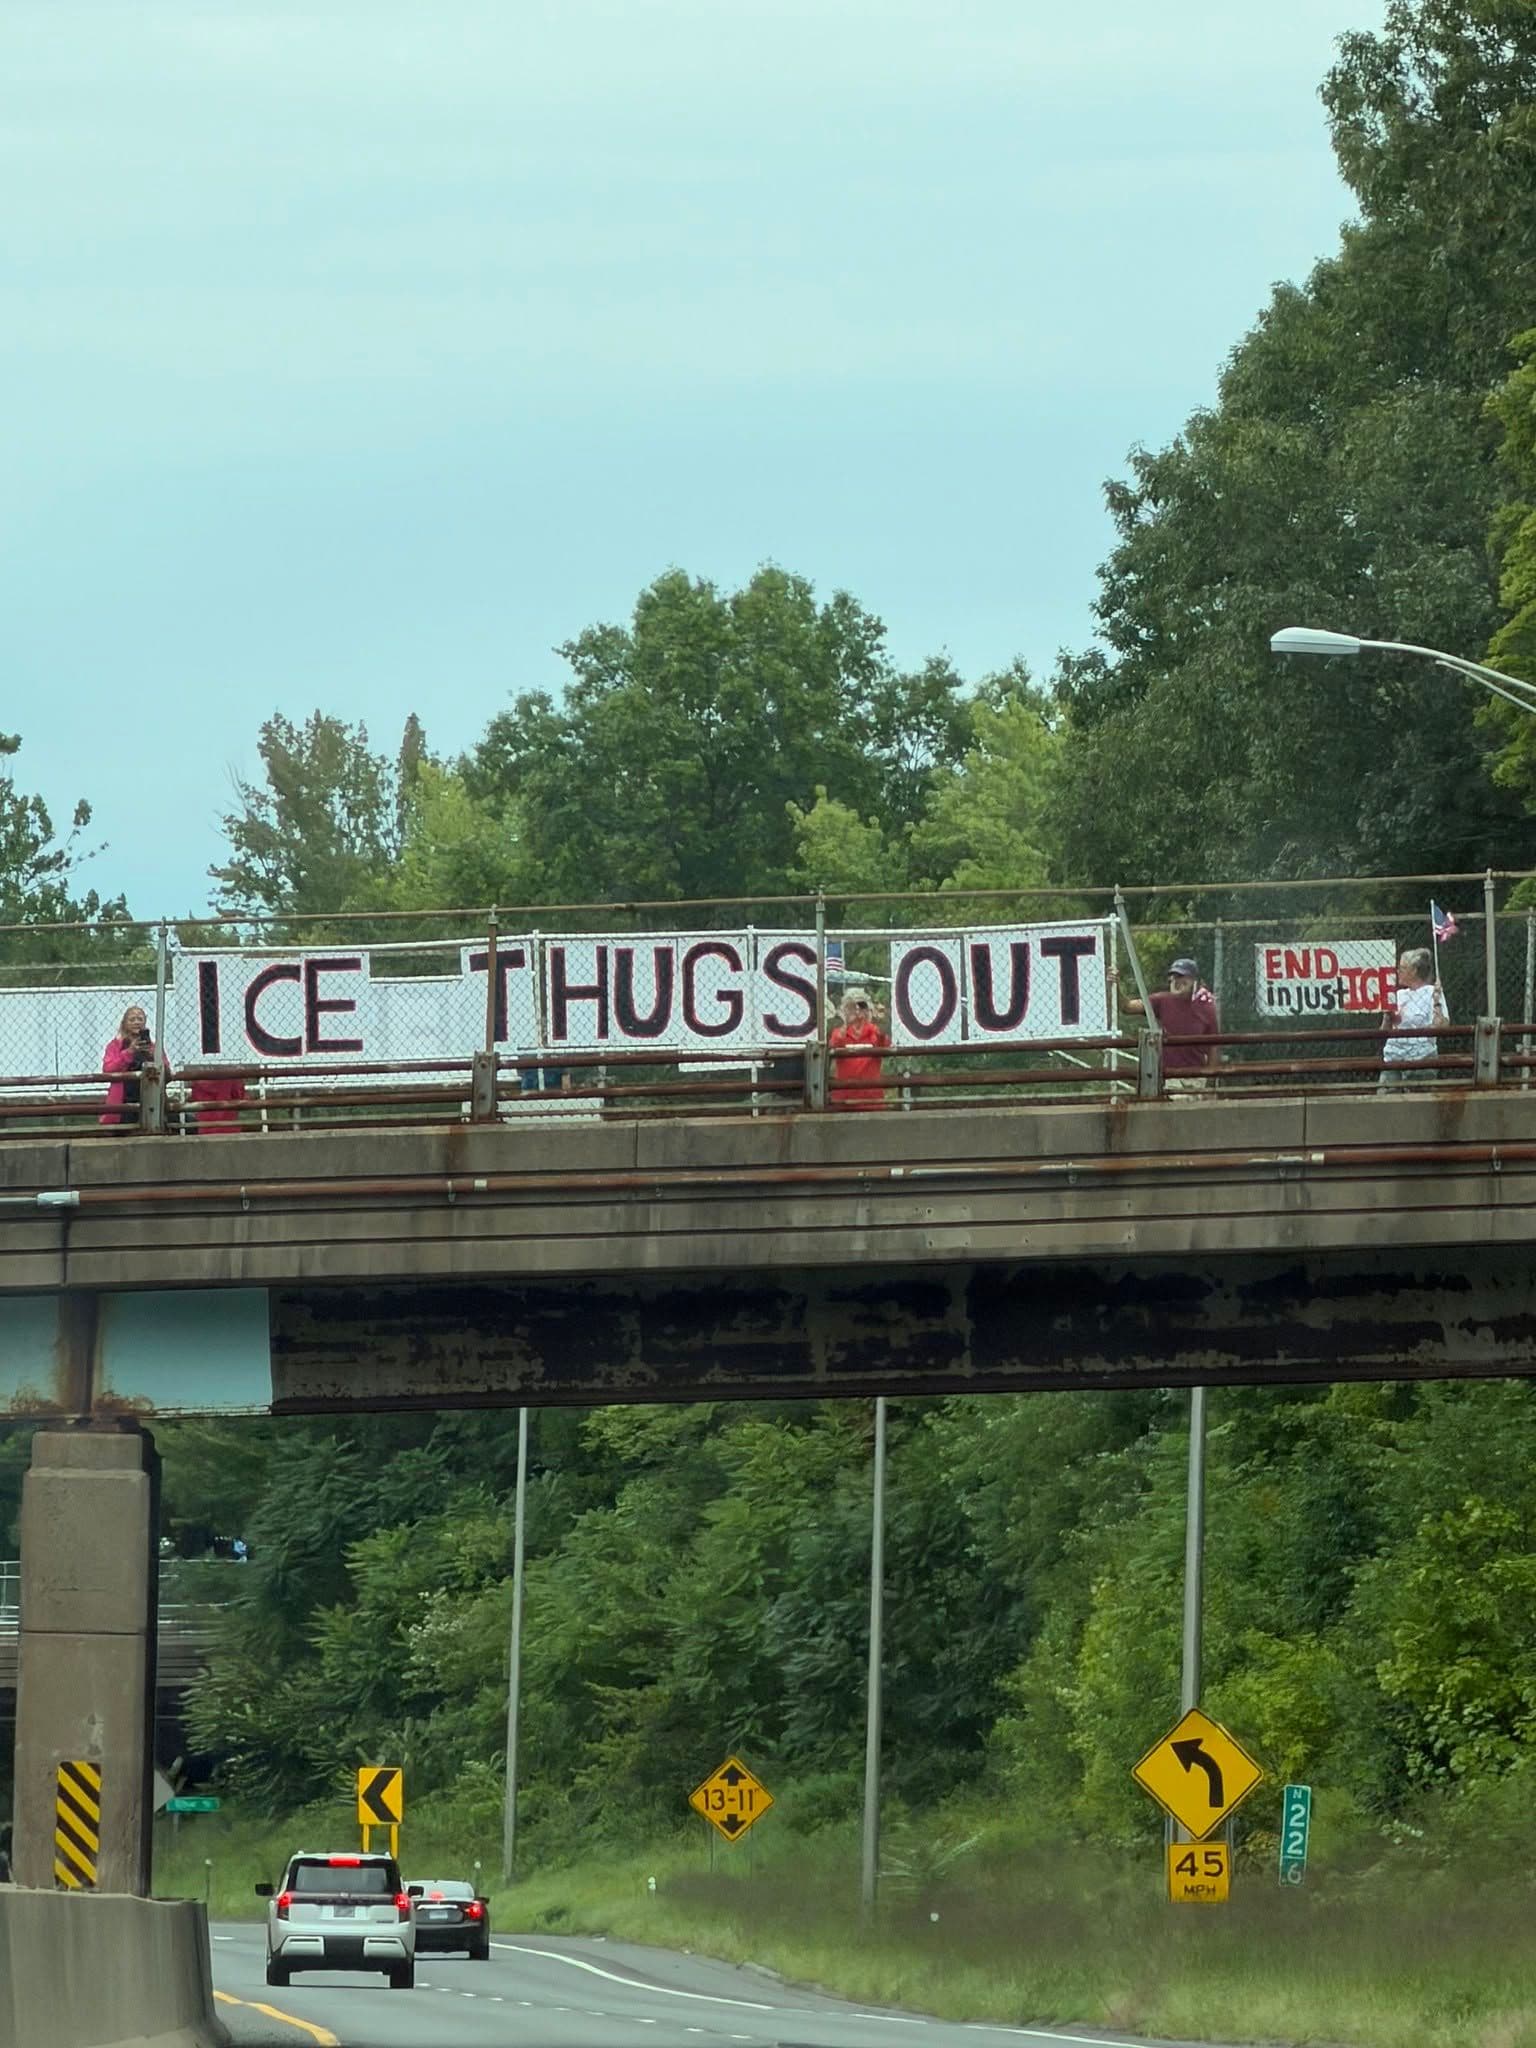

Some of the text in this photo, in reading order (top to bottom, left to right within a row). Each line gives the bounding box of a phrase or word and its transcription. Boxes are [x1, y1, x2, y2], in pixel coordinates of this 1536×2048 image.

[1265, 947, 1339, 979] END
[198, 935, 1096, 1057] ICE THUGS OUT
[1175, 1851, 1224, 1878] 45
[1183, 1884, 1217, 1897] MPH
